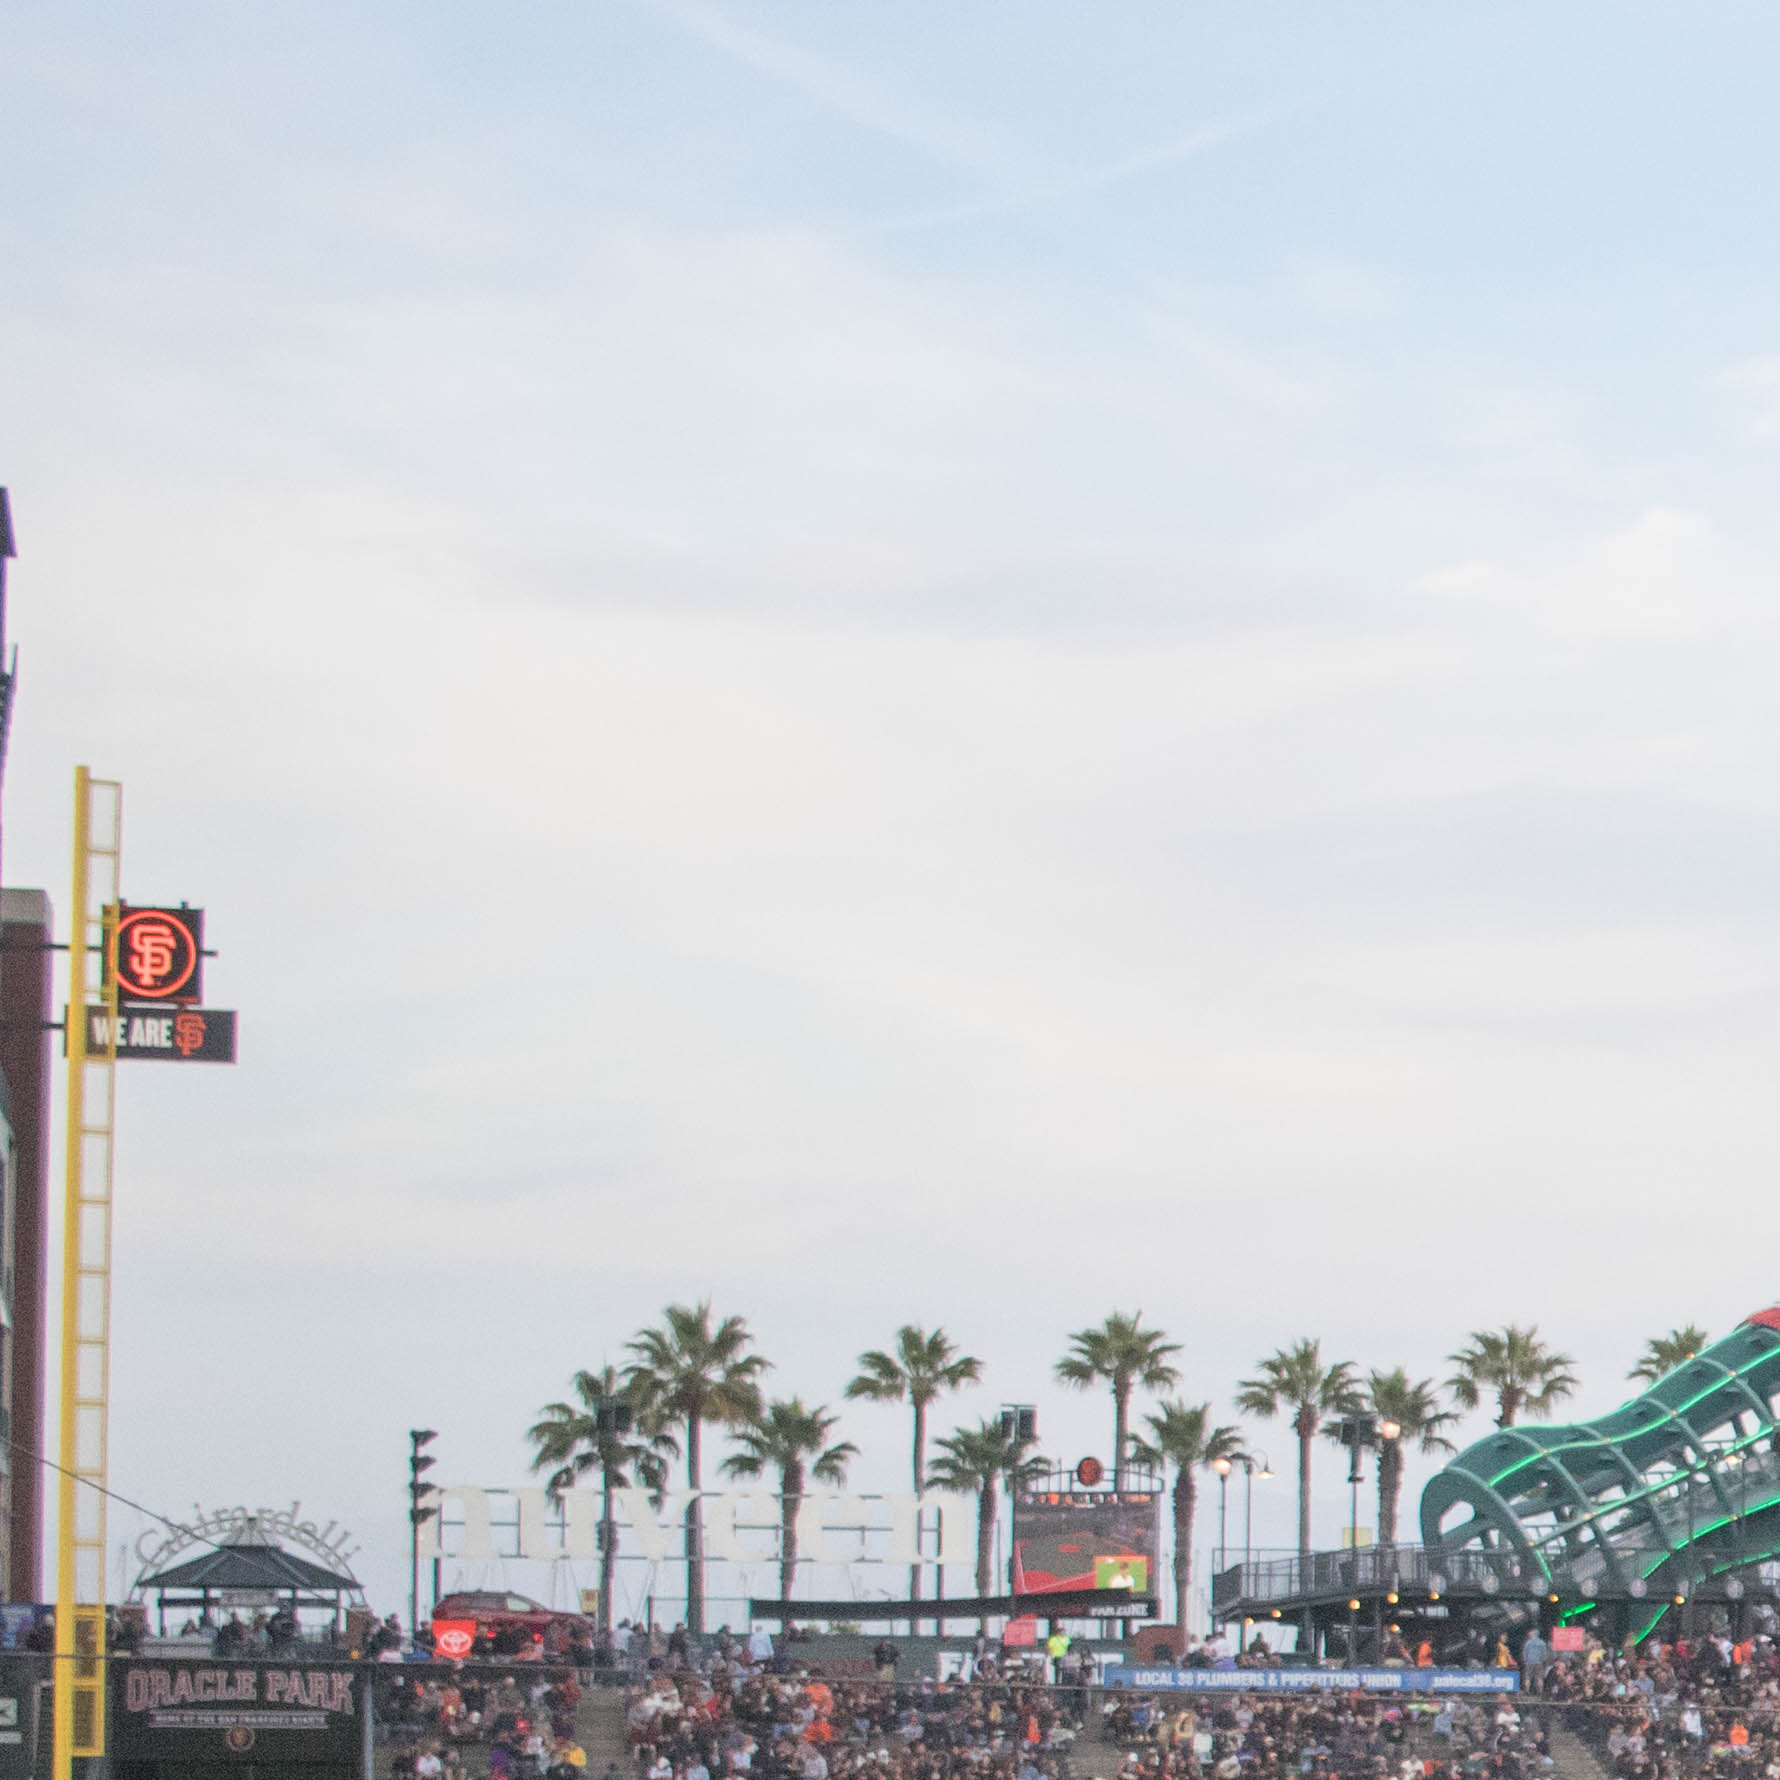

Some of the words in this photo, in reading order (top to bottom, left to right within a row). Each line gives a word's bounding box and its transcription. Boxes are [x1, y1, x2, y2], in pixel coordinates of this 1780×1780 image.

[129, 923, 177, 986] SF
[91, 1015, 127, 1047] WE
[130, 1017, 173, 1049] ARE
[125, 1668, 257, 1713] ORACLE
[264, 1671, 355, 1717] PARK
[1196, 1671, 1265, 1687] PLUMBERS
